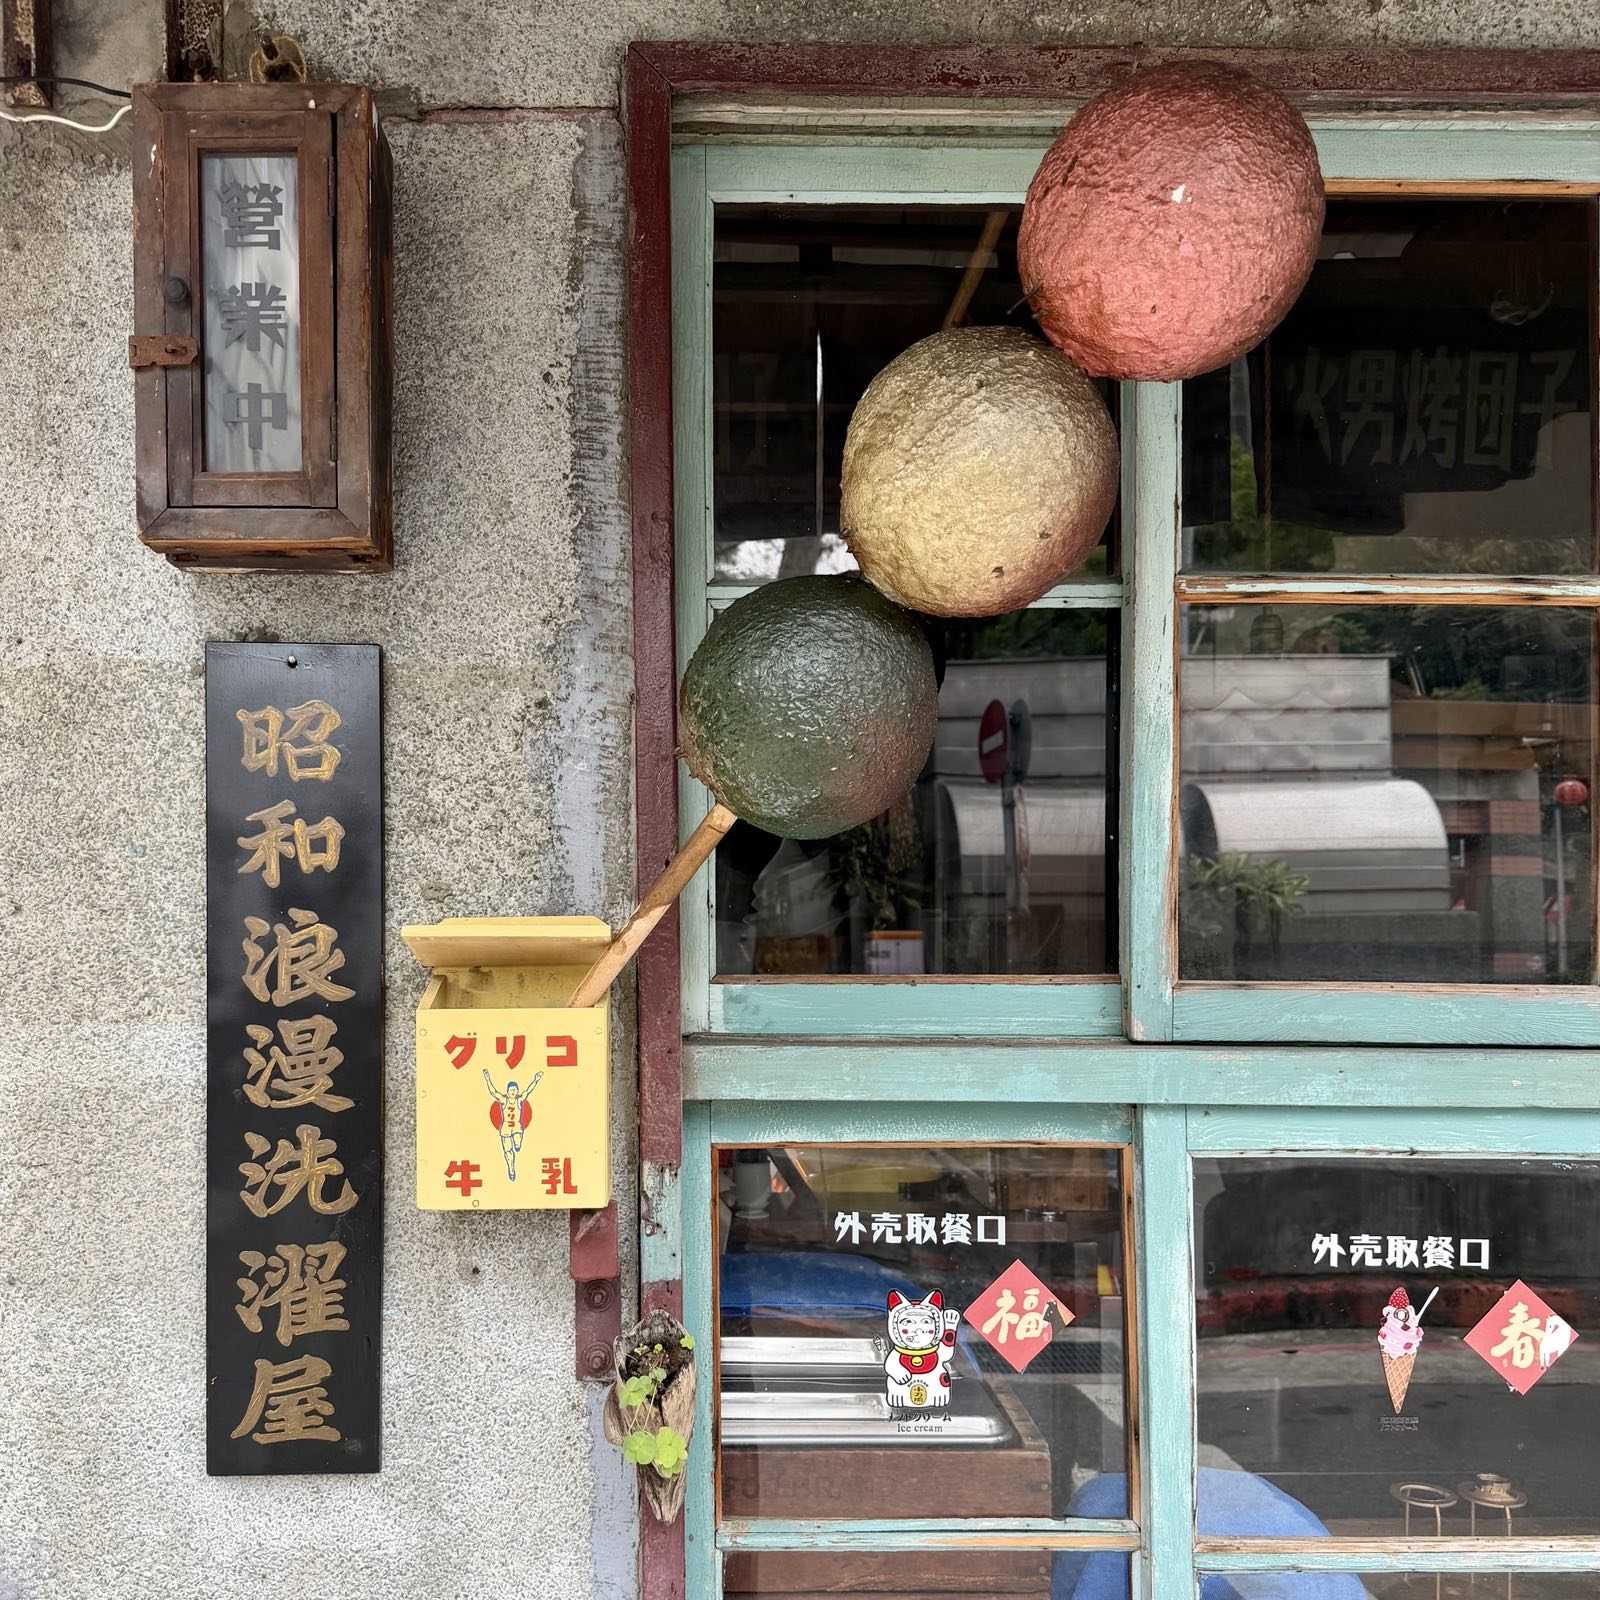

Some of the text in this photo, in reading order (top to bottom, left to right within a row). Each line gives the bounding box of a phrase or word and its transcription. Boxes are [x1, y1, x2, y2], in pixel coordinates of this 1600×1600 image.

[221, 182, 287, 450] 營業中
[231, 699, 359, 1443] 昭和浪漫洗濯屋
[444, 1032, 578, 1070] グリコ
[834, 1211, 1006, 1246] 外売取餐口
[1311, 1233, 1490, 1270] 外売取餐口
[982, 1288, 1043, 1344] 福
[1490, 1301, 1545, 1369] 春
[914, 1425, 943, 1433] cream
